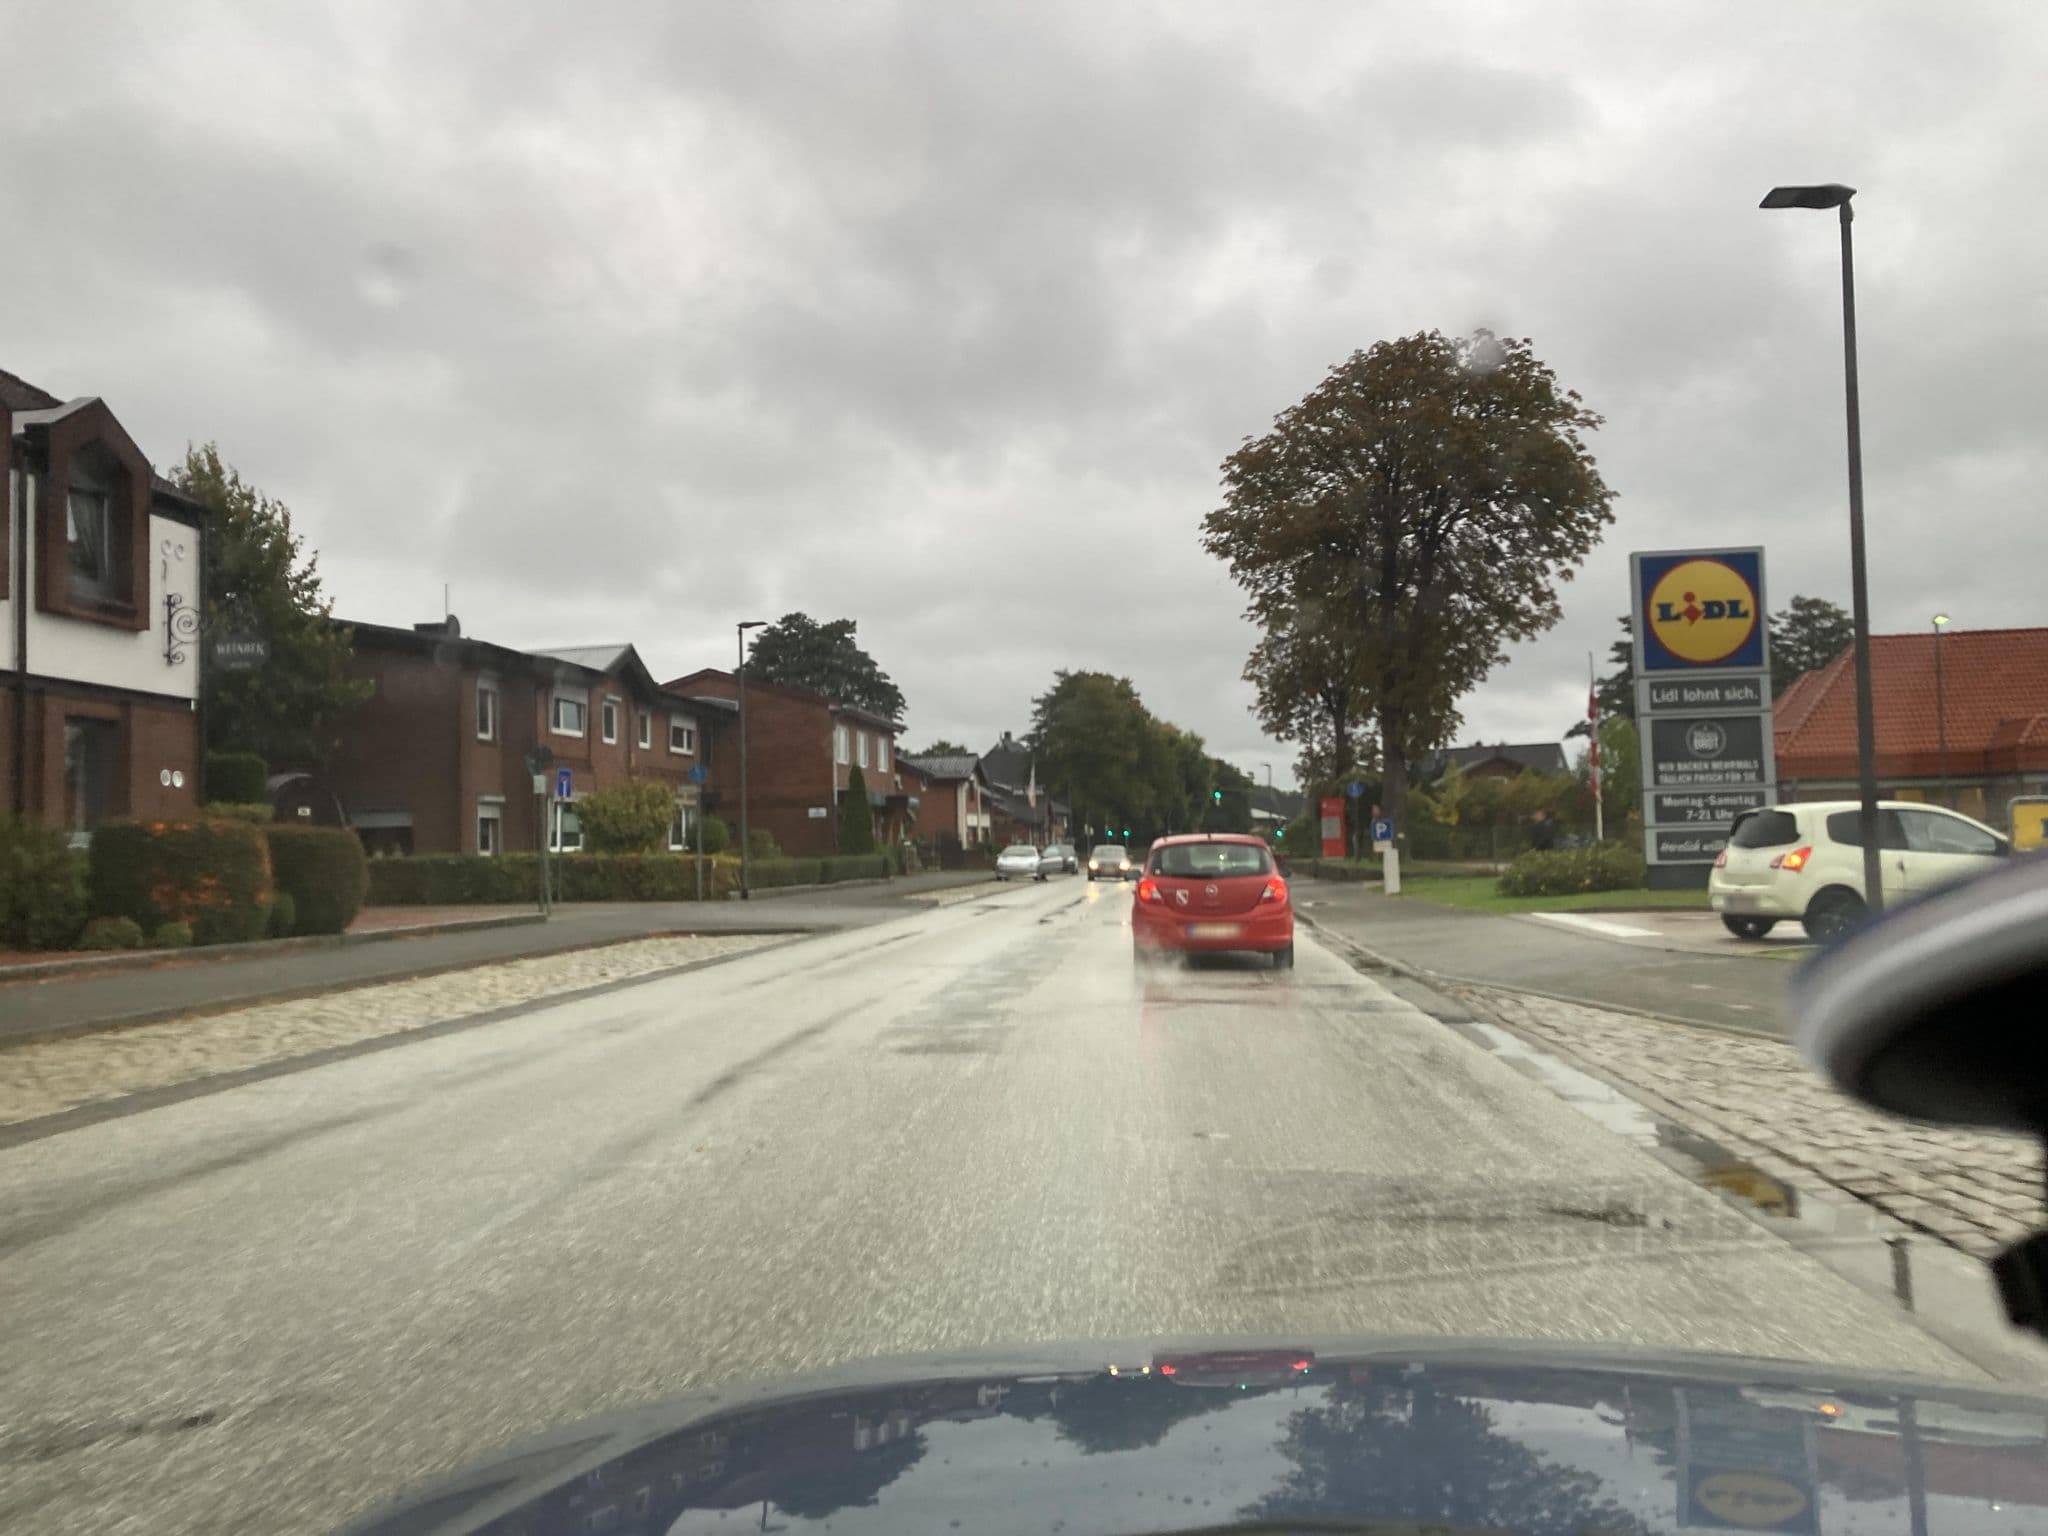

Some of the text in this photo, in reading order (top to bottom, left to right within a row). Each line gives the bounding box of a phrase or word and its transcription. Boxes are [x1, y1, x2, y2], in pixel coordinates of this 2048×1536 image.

[1652, 686, 1759, 704] Lidl lohnt sich.
[1686, 809, 1734, 820] 7-21 Uhr
[1376, 822, 1388, 839] P
